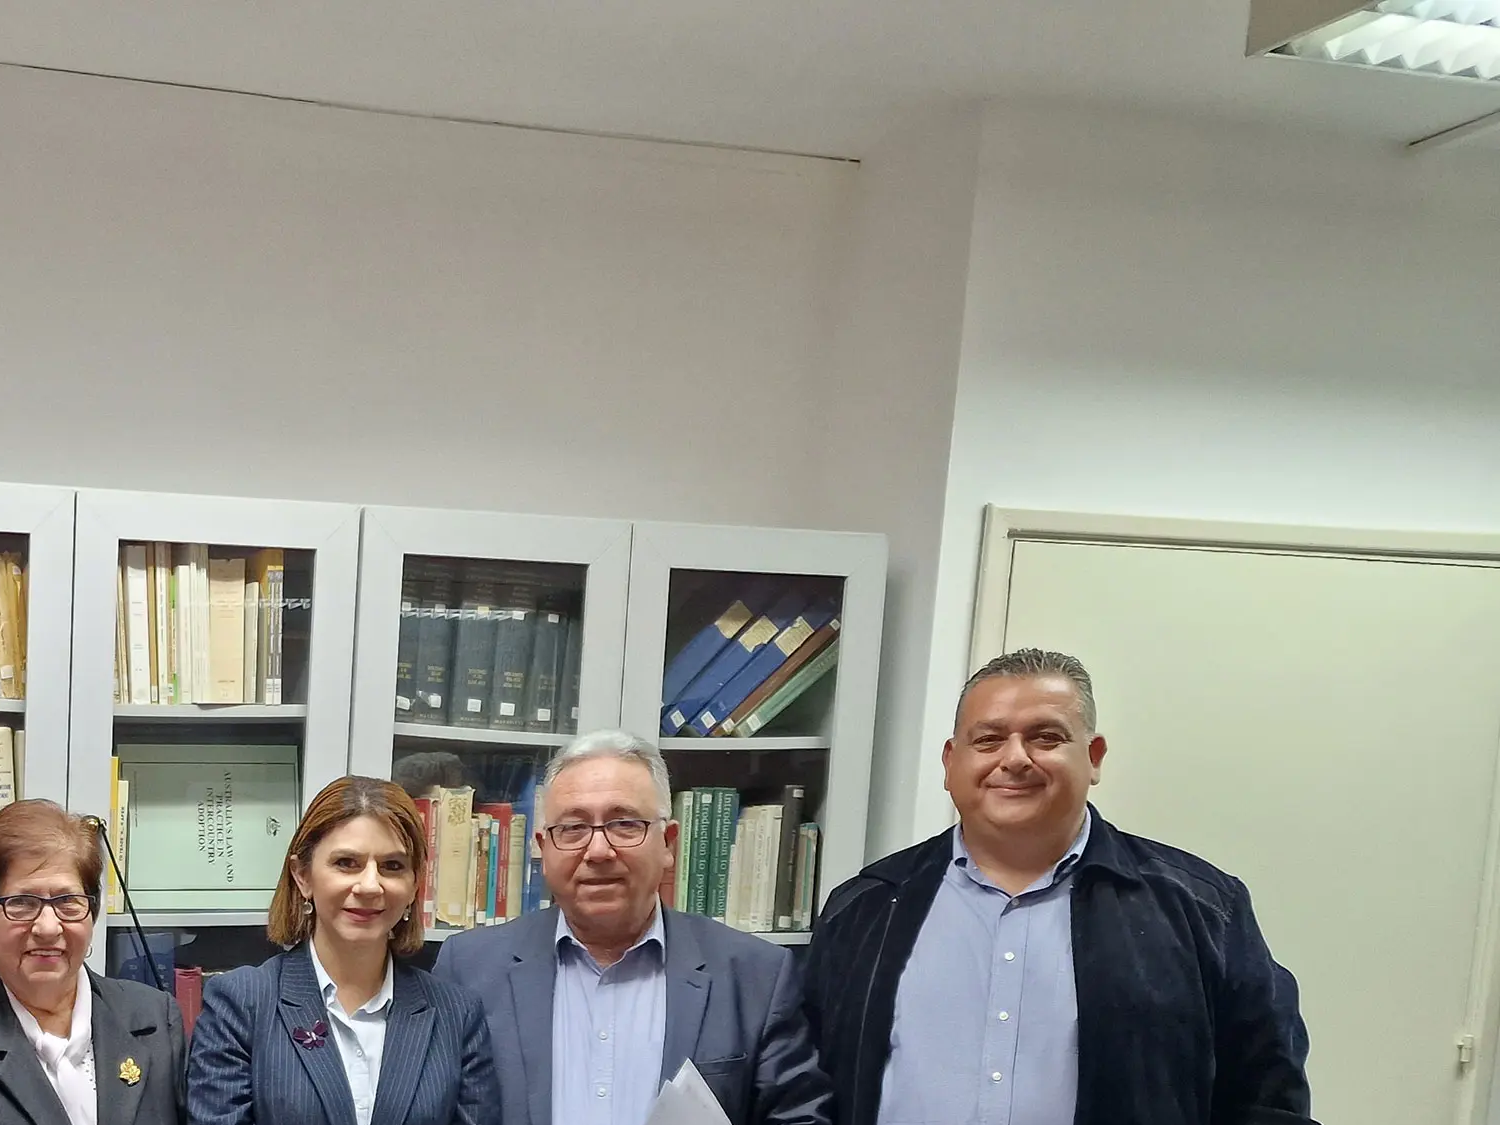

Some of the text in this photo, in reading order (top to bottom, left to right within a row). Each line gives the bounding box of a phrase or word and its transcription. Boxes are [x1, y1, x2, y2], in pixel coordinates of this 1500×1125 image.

[197, 800, 205, 852] ADOPTION
[206, 787, 215, 865] INTERCOUNTRY
[216, 794, 224, 858] PRACTICE IN
[223, 770, 233, 833] AUSTRALIA'S
[695, 793, 710, 913] troduction to psychol
[717, 793, 733, 915] Introduction to psycholo
